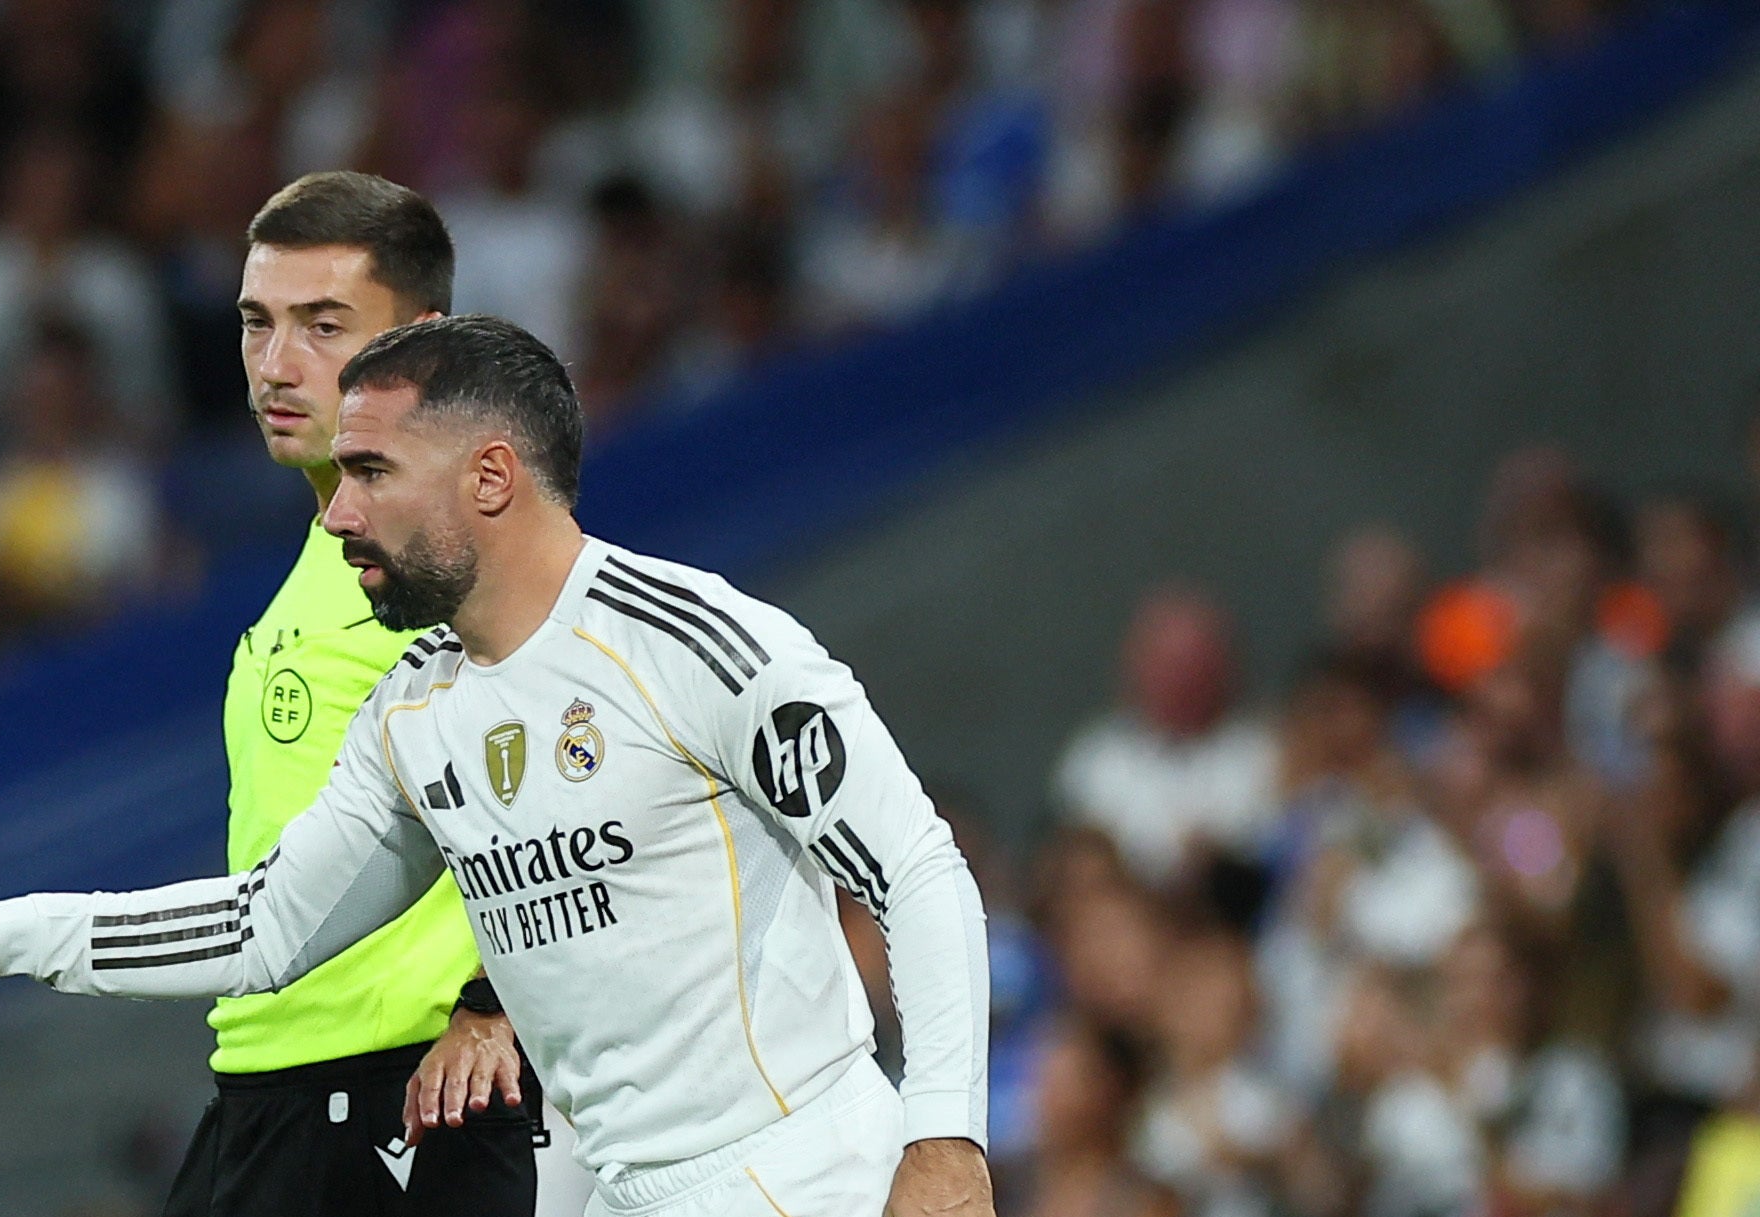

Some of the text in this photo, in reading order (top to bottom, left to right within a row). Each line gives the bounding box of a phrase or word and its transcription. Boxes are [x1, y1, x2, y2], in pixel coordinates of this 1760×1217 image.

[442, 820, 634, 900] Emirates
[480, 882, 618, 955] FLY BETTER
